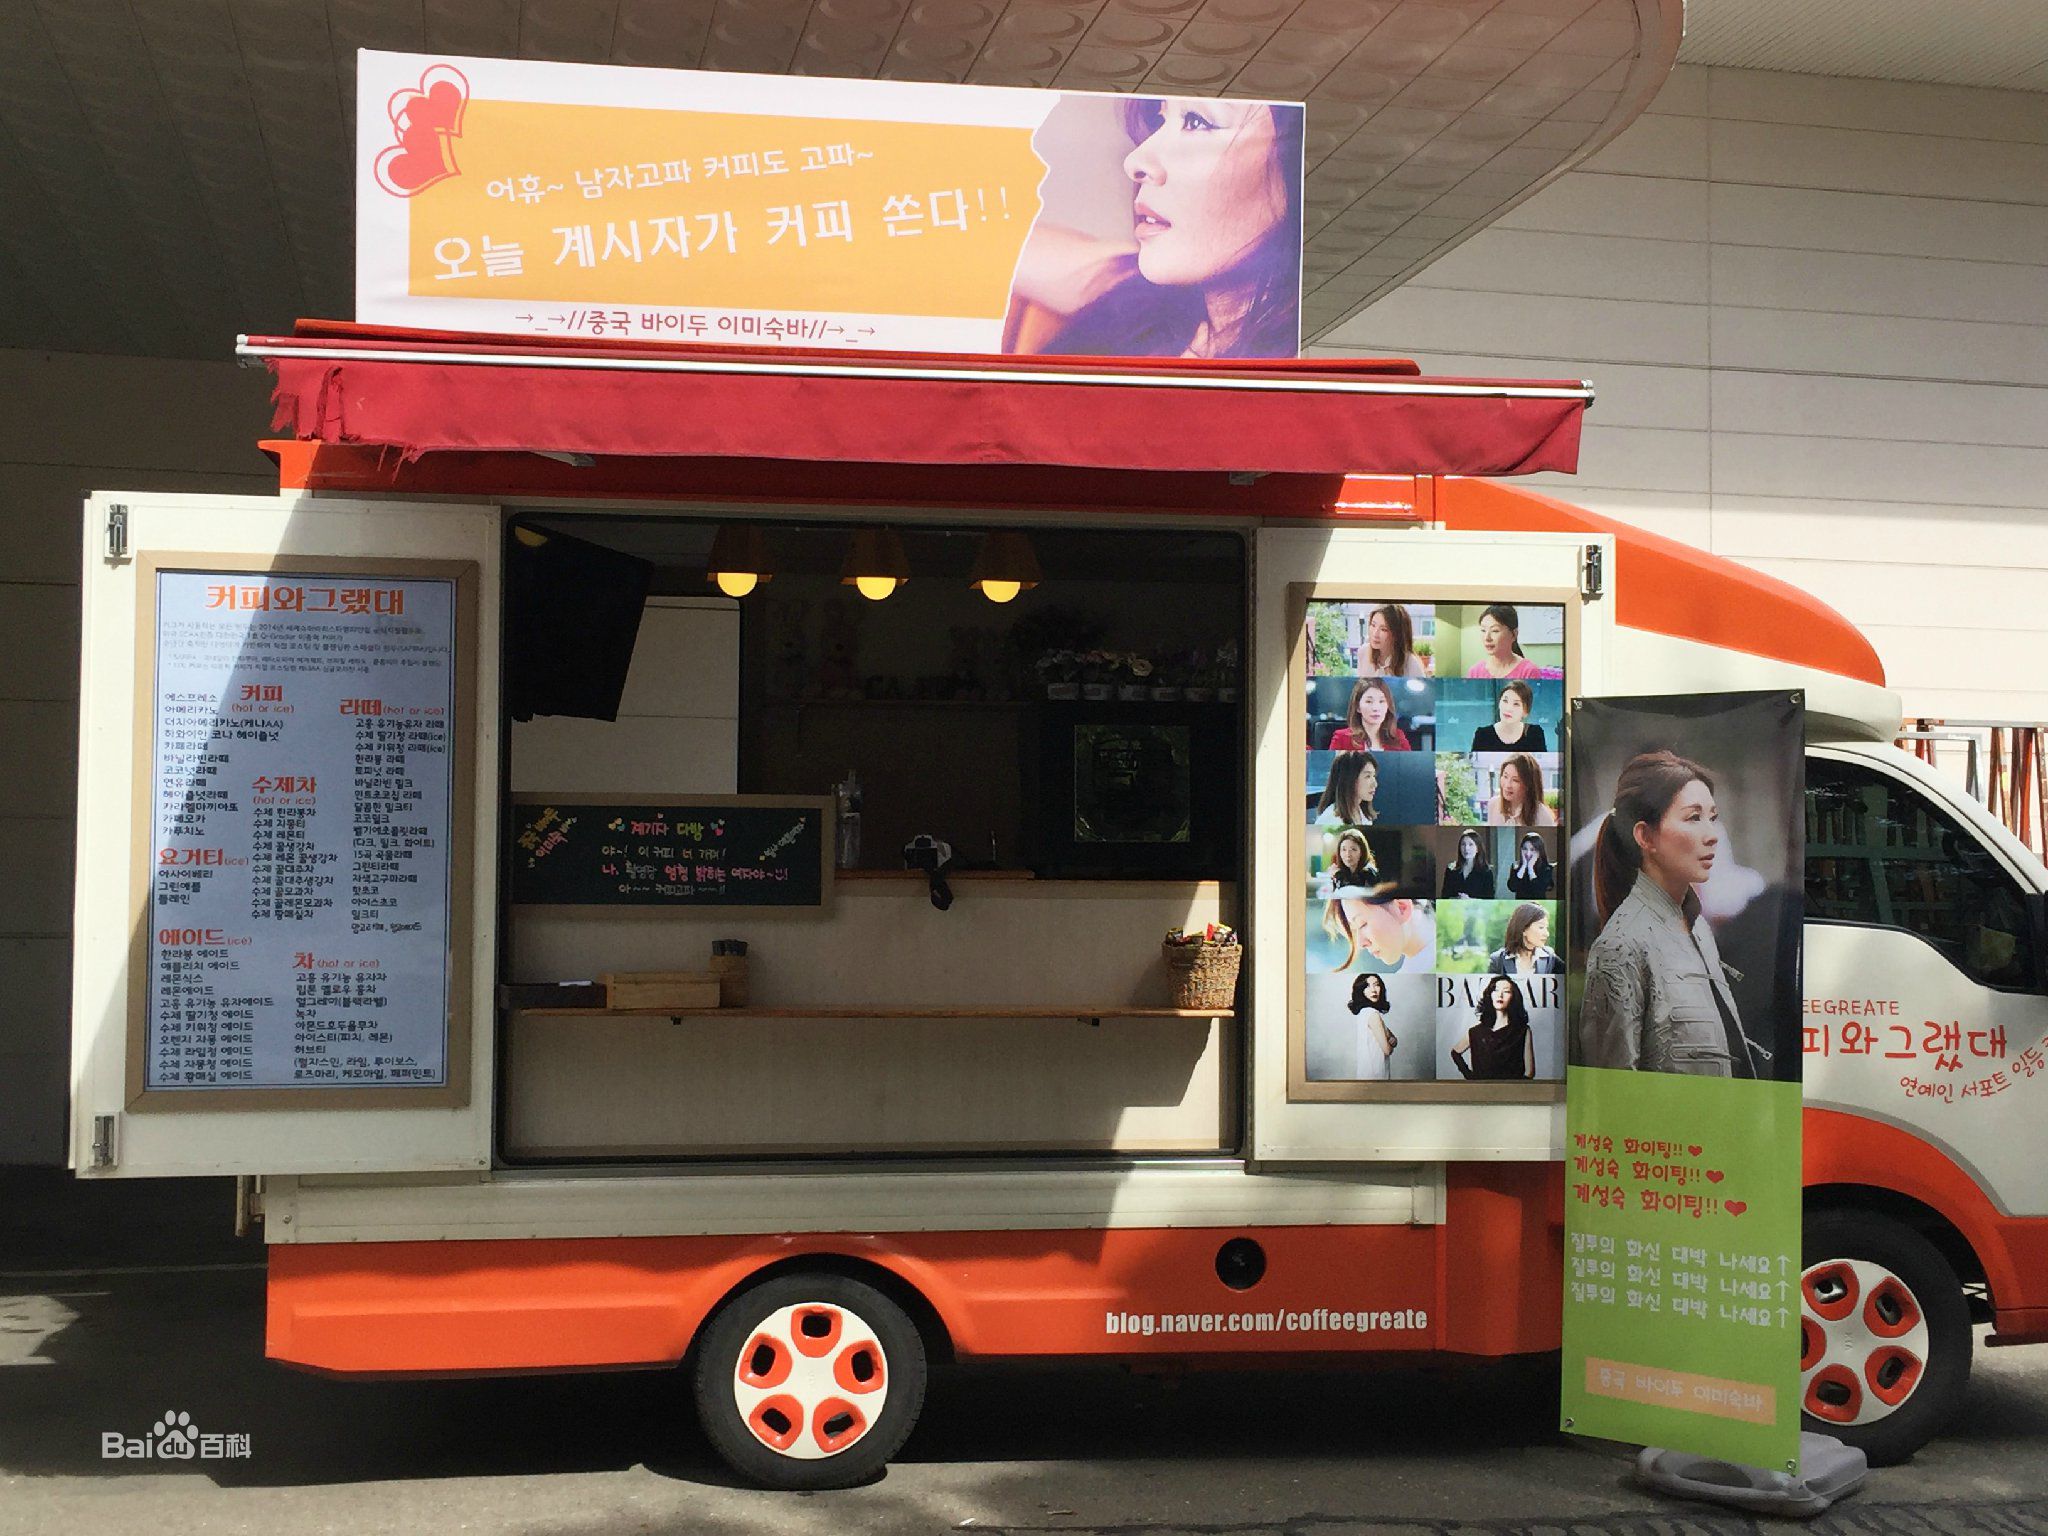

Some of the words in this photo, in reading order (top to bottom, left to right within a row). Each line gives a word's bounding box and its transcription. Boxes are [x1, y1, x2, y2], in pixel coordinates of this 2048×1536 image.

[486, 173, 564, 204] 어휴~
[574, 158, 692, 200] 남자고파
[702, 149, 790, 179] 커피도
[799, 142, 874, 173] 고파~
[433, 234, 524, 280] 오늘
[551, 211, 738, 268] 계시자가
[765, 200, 853, 247] 커피
[881, 185, 1010, 237] 쏜다!!
[640, 314, 709, 338] 바이두
[206, 584, 404, 615] 커피와그랬대
[241, 685, 283, 702] 커피
[340, 699, 382, 716] 라떼
[164, 706, 219, 716] 아메리카노
[252, 776, 318, 794] 수제차
[158, 848, 224, 866] 요거티
[159, 929, 225, 946] 에이드
[292, 952, 315, 970] 차
[1900, 1076, 1953, 1104] 연예인
[1960, 1071, 2012, 1098] 서포트
[1573, 1134, 1613, 1153] 계성숙
[1623, 1137, 1683, 1159] 화이팅!!
[1574, 1155, 1619, 1180] 계성숙
[1632, 1161, 1700, 1186] 화이팅!!
[1572, 1183, 1625, 1210] 계성숙
[1640, 1189, 1718, 1218] 화이팅!!
[1570, 1232, 1614, 1255] 질투의
[1625, 1238, 1660, 1262] 화신
[1671, 1245, 1708, 1268] 대박
[1719, 1253, 1771, 1274] 나세요
[1571, 1257, 1615, 1280] 질투의
[1626, 1264, 1661, 1287] 화신
[1672, 1271, 1708, 1294] 대박
[1719, 1278, 1771, 1300] 나세요
[1571, 1282, 1615, 1304] 질투의
[1626, 1289, 1661, 1312] 화신
[1672, 1297, 1708, 1319] 대박
[1719, 1304, 1771, 1327] 나세요
[1106, 1309, 1428, 1334] blog.naver.com/coffeegreate
[1599, 1367, 1625, 1391] 중국
[1636, 1373, 1683, 1396] 바이두
[1693, 1382, 1764, 1412] 이미숙바
